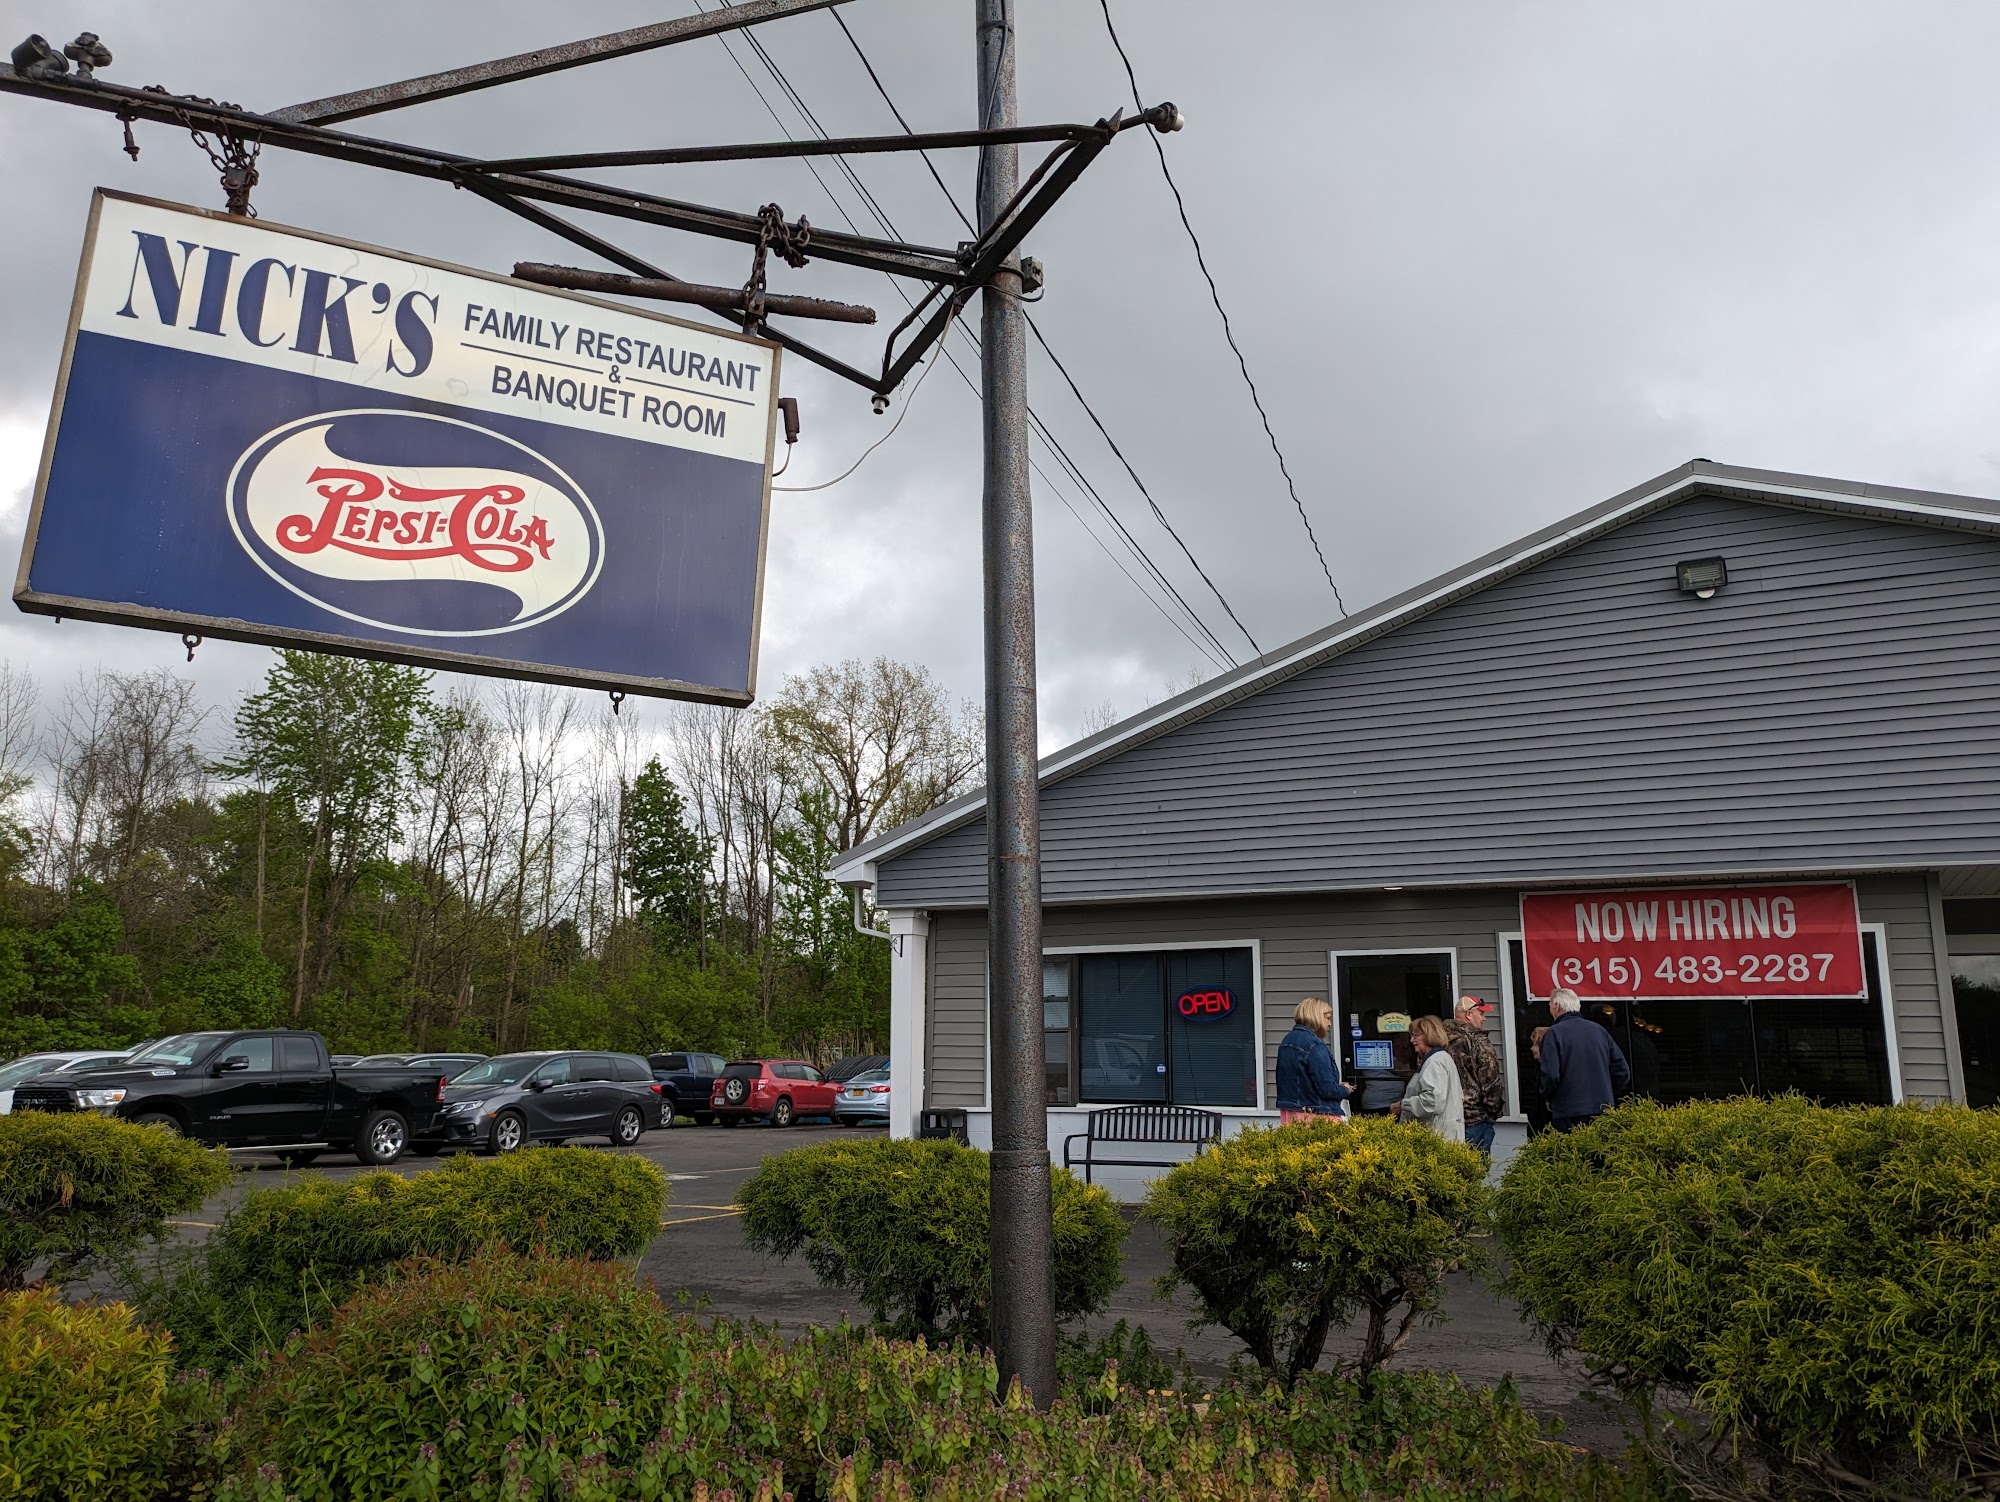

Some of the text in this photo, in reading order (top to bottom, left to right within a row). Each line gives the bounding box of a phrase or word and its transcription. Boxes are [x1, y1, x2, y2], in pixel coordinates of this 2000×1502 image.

[116, 230, 440, 378] NICK'S
[464, 303, 761, 392] FAMILY RESTAURANT
[608, 364, 622, 384] &
[491, 364, 727, 438] BANQUET ROOM
[1574, 896, 1797, 943] NOW HIRING
[1551, 953, 1834, 991] (315) 483-2287
[1179, 991, 1231, 1015] OPEN
[1384, 1023, 1405, 1031] OPEN
